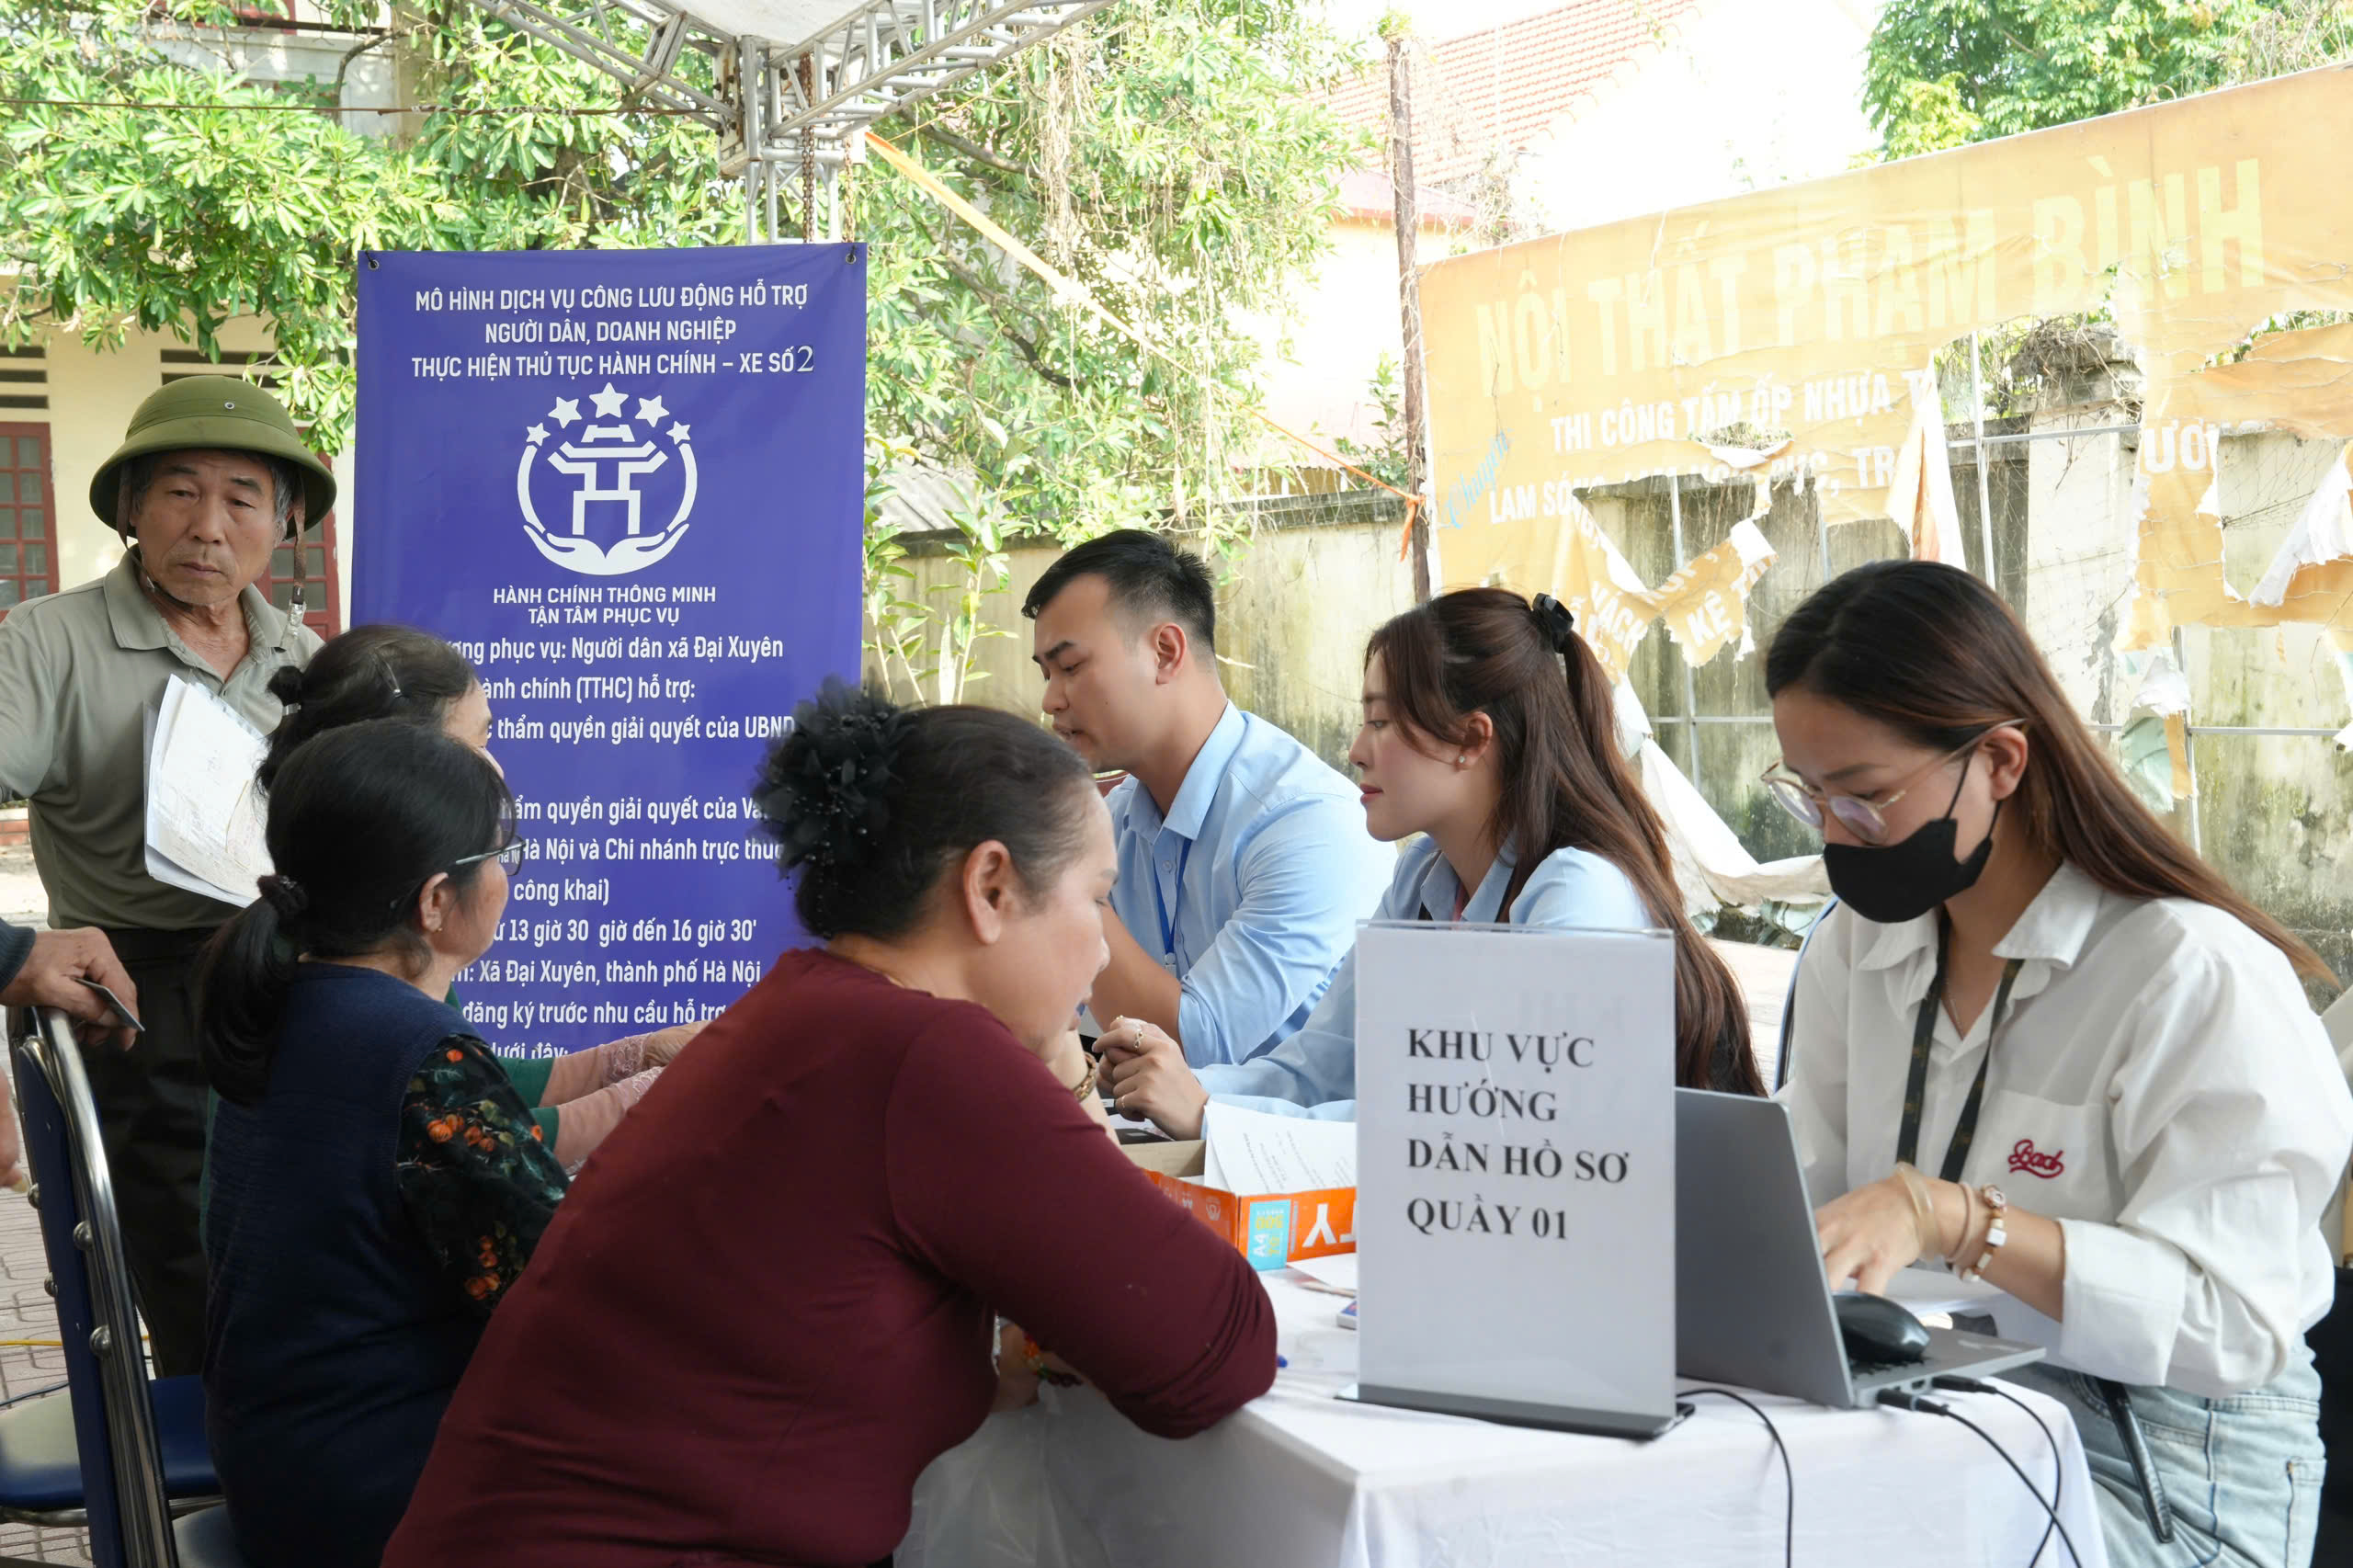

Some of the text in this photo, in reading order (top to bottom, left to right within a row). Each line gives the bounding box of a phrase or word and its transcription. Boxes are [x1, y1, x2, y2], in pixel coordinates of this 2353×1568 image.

[415, 278, 808, 314] MÔ HÌNH DỊCH VỤ CÔNG LƯU ĐỘNG HỖ TRỢ
[485, 315, 737, 346] NGƯỜI DÂN, DOANH NGHIỆP
[411, 356, 462, 382] THỰC
[467, 352, 511, 382] HIỆN
[515, 350, 552, 376] THỦ
[556, 355, 594, 381] TỤC
[598, 350, 651, 375] HÀNH
[656, 349, 716, 374] CHÍNH
[739, 352, 763, 373] XE
[768, 346, 795, 373] SỐ
[797, 345, 814, 372] 2
[1551, 413, 1592, 452] THI
[1601, 397, 1676, 447] CÔNG
[1804, 371, 1894, 427] NHỰA
[493, 584, 716, 604] HÀNH CHÍNH THÔNG MINH
[528, 605, 680, 628] TẬN TÂM PHỤC VỤ
[489, 637, 536, 665] phục
[539, 642, 566, 665] vụ:
[571, 636, 623, 665] Người
[628, 636, 663, 659] dân
[667, 636, 688, 659] xã
[693, 635, 723, 664] Đại
[727, 635, 783, 664] Xuyên
[483, 673, 696, 704] ành chính (TTHC) hỗ trợ:
[497, 713, 544, 739] thẩm
[550, 713, 606, 745] quyền
[611, 715, 644, 745] giải
[649, 713, 701, 745] quyết
[705, 715, 739, 739] của
[547, 794, 603, 825] quyền
[608, 796, 642, 826] giải
[647, 794, 699, 825] quyết
[703, 796, 737, 820] của
[545, 837, 574, 866] Nội
[578, 836, 600, 860] và
[605, 837, 634, 860] Chi
[640, 837, 698, 860] nhánh
[702, 839, 740, 865] trực
[513, 878, 609, 907] công khai)
[508, 918, 529, 941] 13
[534, 919, 563, 948] giờ
[566, 918, 589, 941] 30
[599, 919, 628, 948] giờ
[632, 917, 667, 942] đến
[672, 919, 692, 942] 16
[698, 919, 726, 948] giờ
[478, 960, 501, 983] Xã
[505, 960, 535, 987] Đại
[540, 960, 600, 988] Xuyên,
[606, 960, 658, 983] thành
[663, 958, 699, 987] phố
[703, 960, 726, 983] Hà
[732, 960, 761, 988] Nội
[513, 1000, 535, 1029] ký
[539, 1001, 588, 1024] trước
[593, 1001, 629, 1024] nhu
[633, 999, 667, 1024] cầu
[673, 998, 696, 1024] hỗ
[1408, 1028, 1595, 1074] KHU VỰC
[1408, 1078, 1557, 1122] HƯỚNG
[1408, 1131, 1630, 1184] DẪN HỒ SƠ
[1406, 1193, 1567, 1240] QUẦY 01
